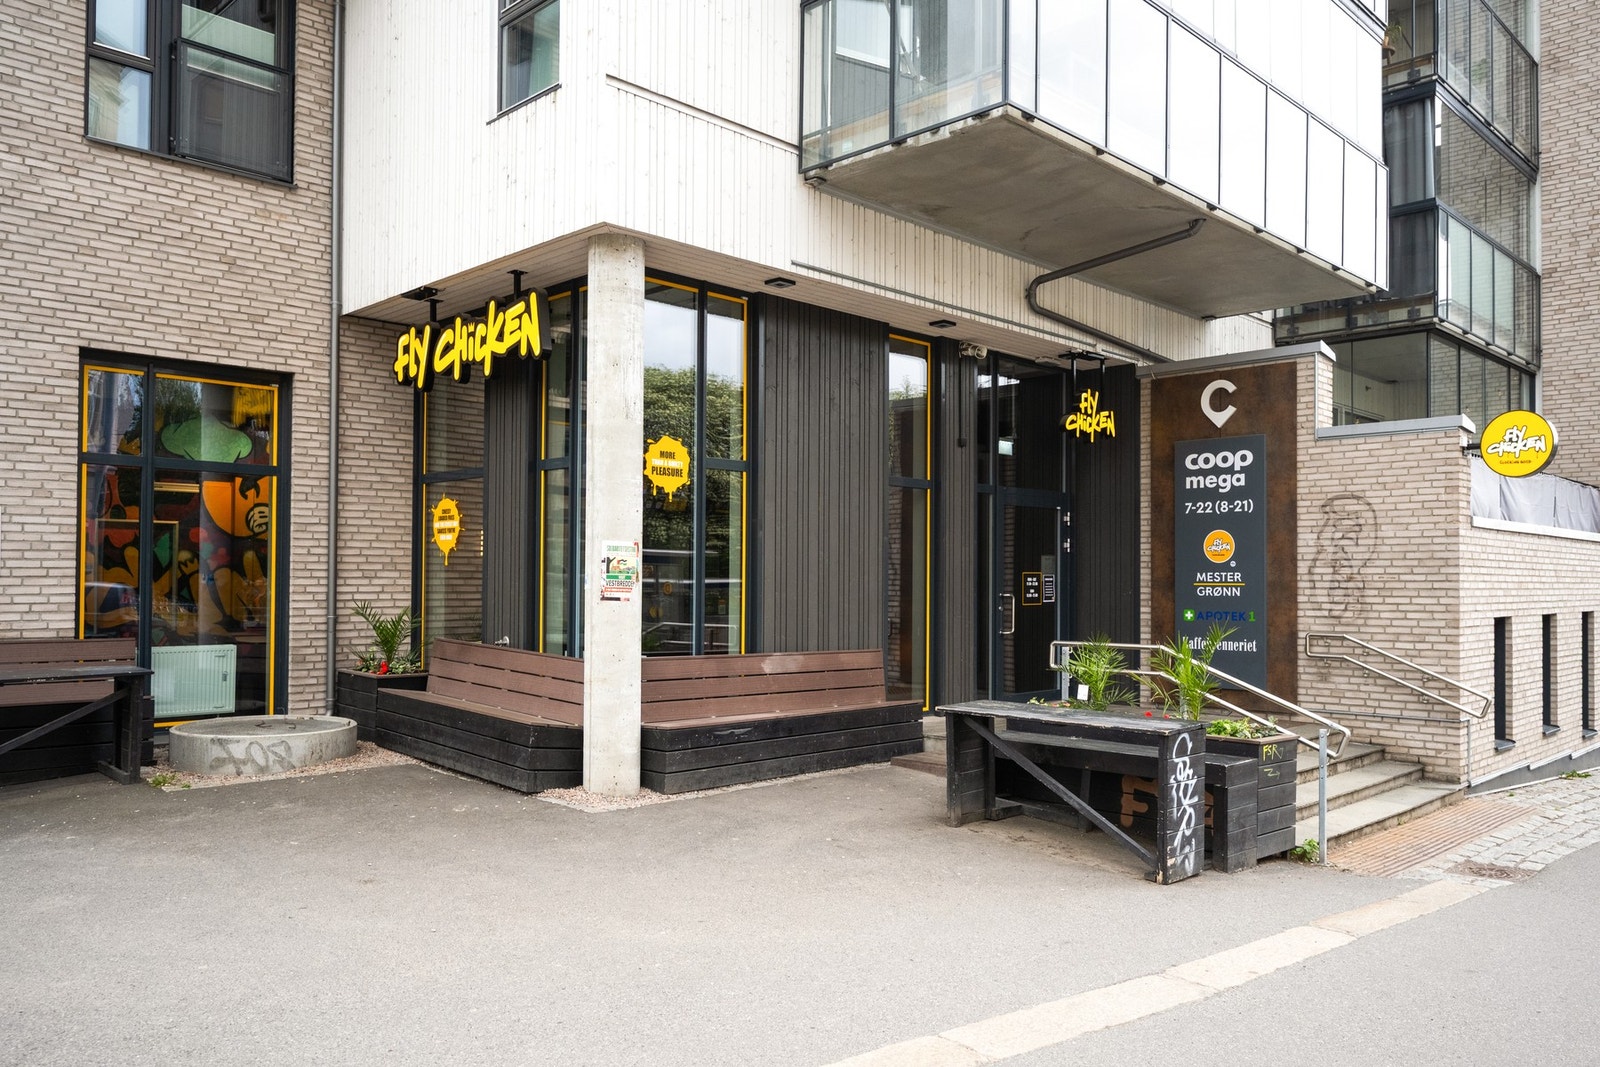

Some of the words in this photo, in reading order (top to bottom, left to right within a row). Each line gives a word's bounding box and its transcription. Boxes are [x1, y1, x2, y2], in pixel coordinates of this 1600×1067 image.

[659, 450, 676, 460] MORE
[1185, 449, 1254, 471] coop
[651, 466, 683, 478] PLEASURE
[1185, 473, 1246, 493] mega
[1184, 501, 1213, 514] 7-22
[1215, 498, 1254, 515] (8-21)
[1196, 572, 1242, 582] MESTER
[1196, 586, 1241, 597] GRØNN
[1196, 611, 1246, 622] APOTEK
[1248, 610, 1256, 622] 1
[1182, 636, 1258, 652] affeenneriet
